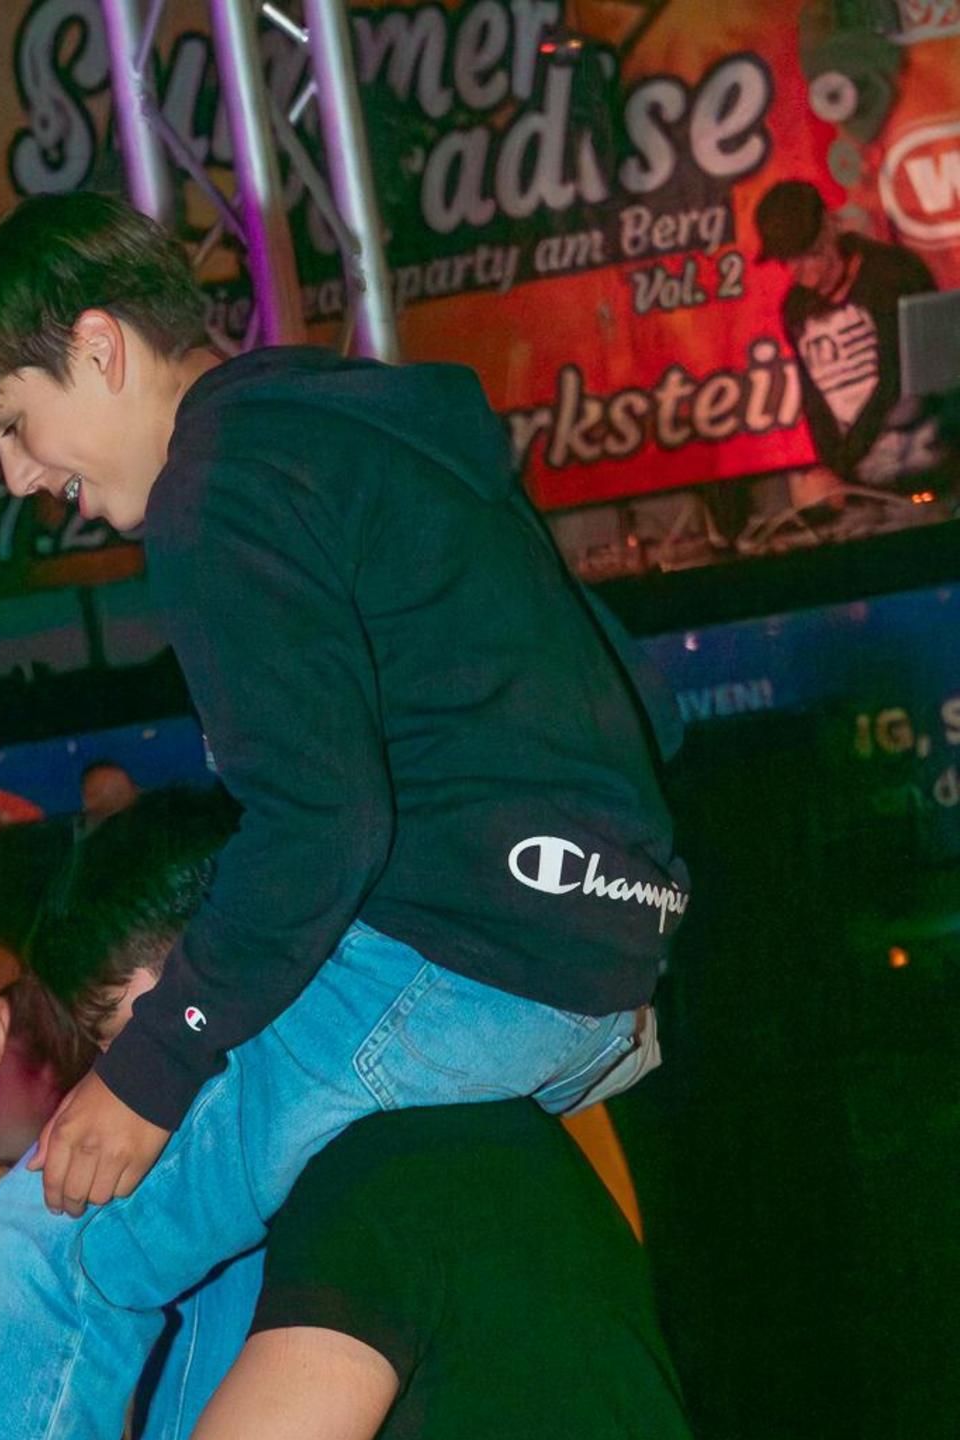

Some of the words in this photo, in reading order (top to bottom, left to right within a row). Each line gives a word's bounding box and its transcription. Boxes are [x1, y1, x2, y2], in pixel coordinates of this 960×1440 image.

[534, 225, 603, 272] am
[619, 204, 727, 256] Berg
[633, 264, 705, 312] Vol.
[719, 256, 743, 297] 2
